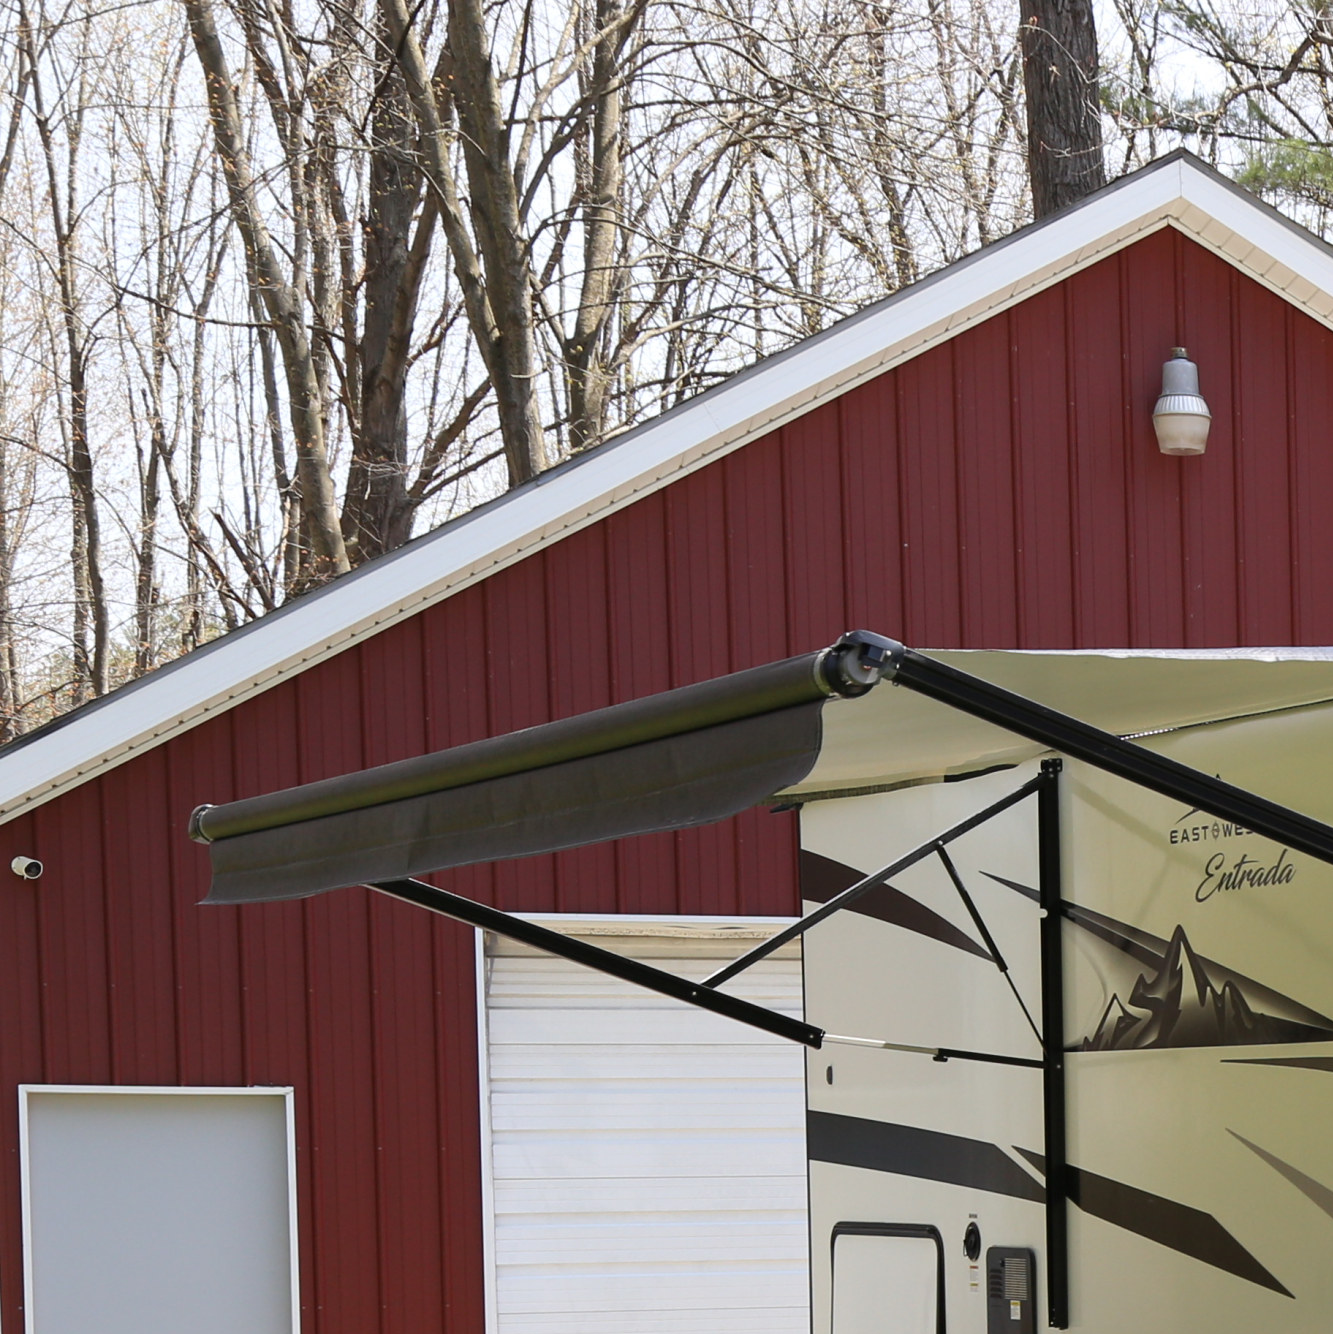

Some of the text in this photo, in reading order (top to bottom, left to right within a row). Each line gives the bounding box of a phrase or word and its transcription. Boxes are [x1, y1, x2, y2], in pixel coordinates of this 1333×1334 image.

[1170, 825, 1209, 844] EAST
[1222, 823, 1254, 837] WE
[1195, 848, 1297, 903] Entrada
